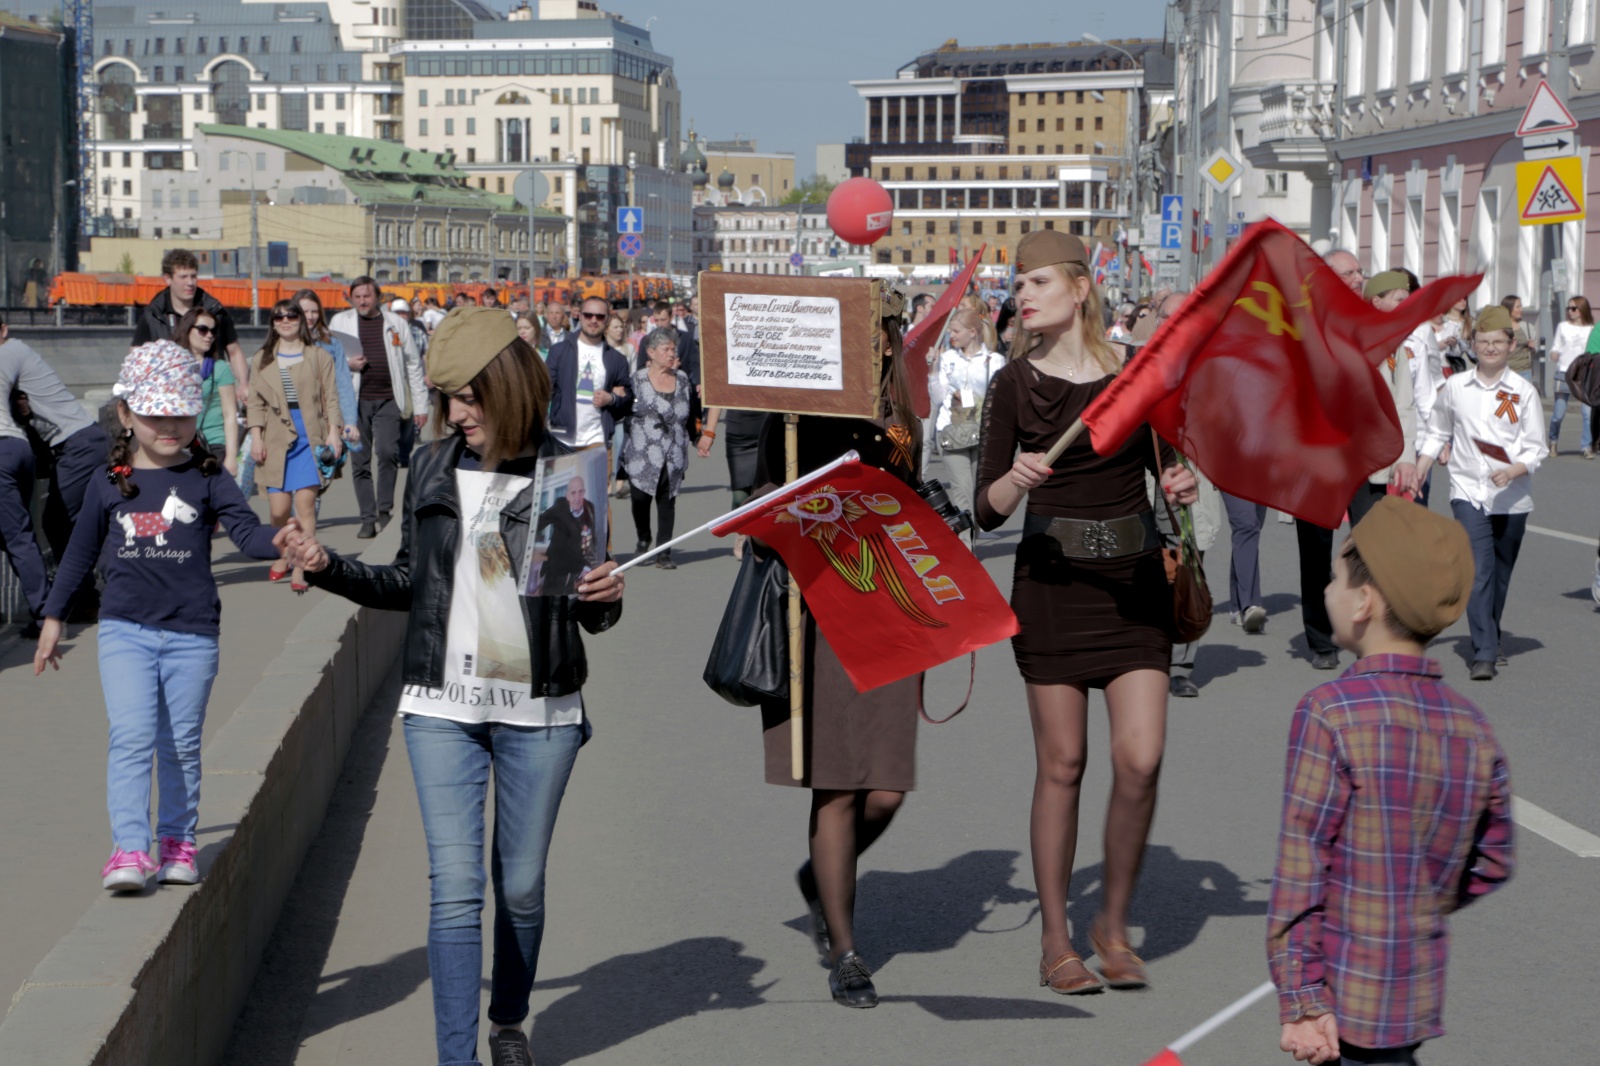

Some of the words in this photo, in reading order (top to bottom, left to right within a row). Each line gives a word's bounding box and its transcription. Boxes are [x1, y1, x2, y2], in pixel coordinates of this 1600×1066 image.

[752, 331, 764, 339] 52
[117, 546, 140, 559] Cool
[143, 545, 192, 564] Vintage
[881, 520, 965, 606] МАЯ
